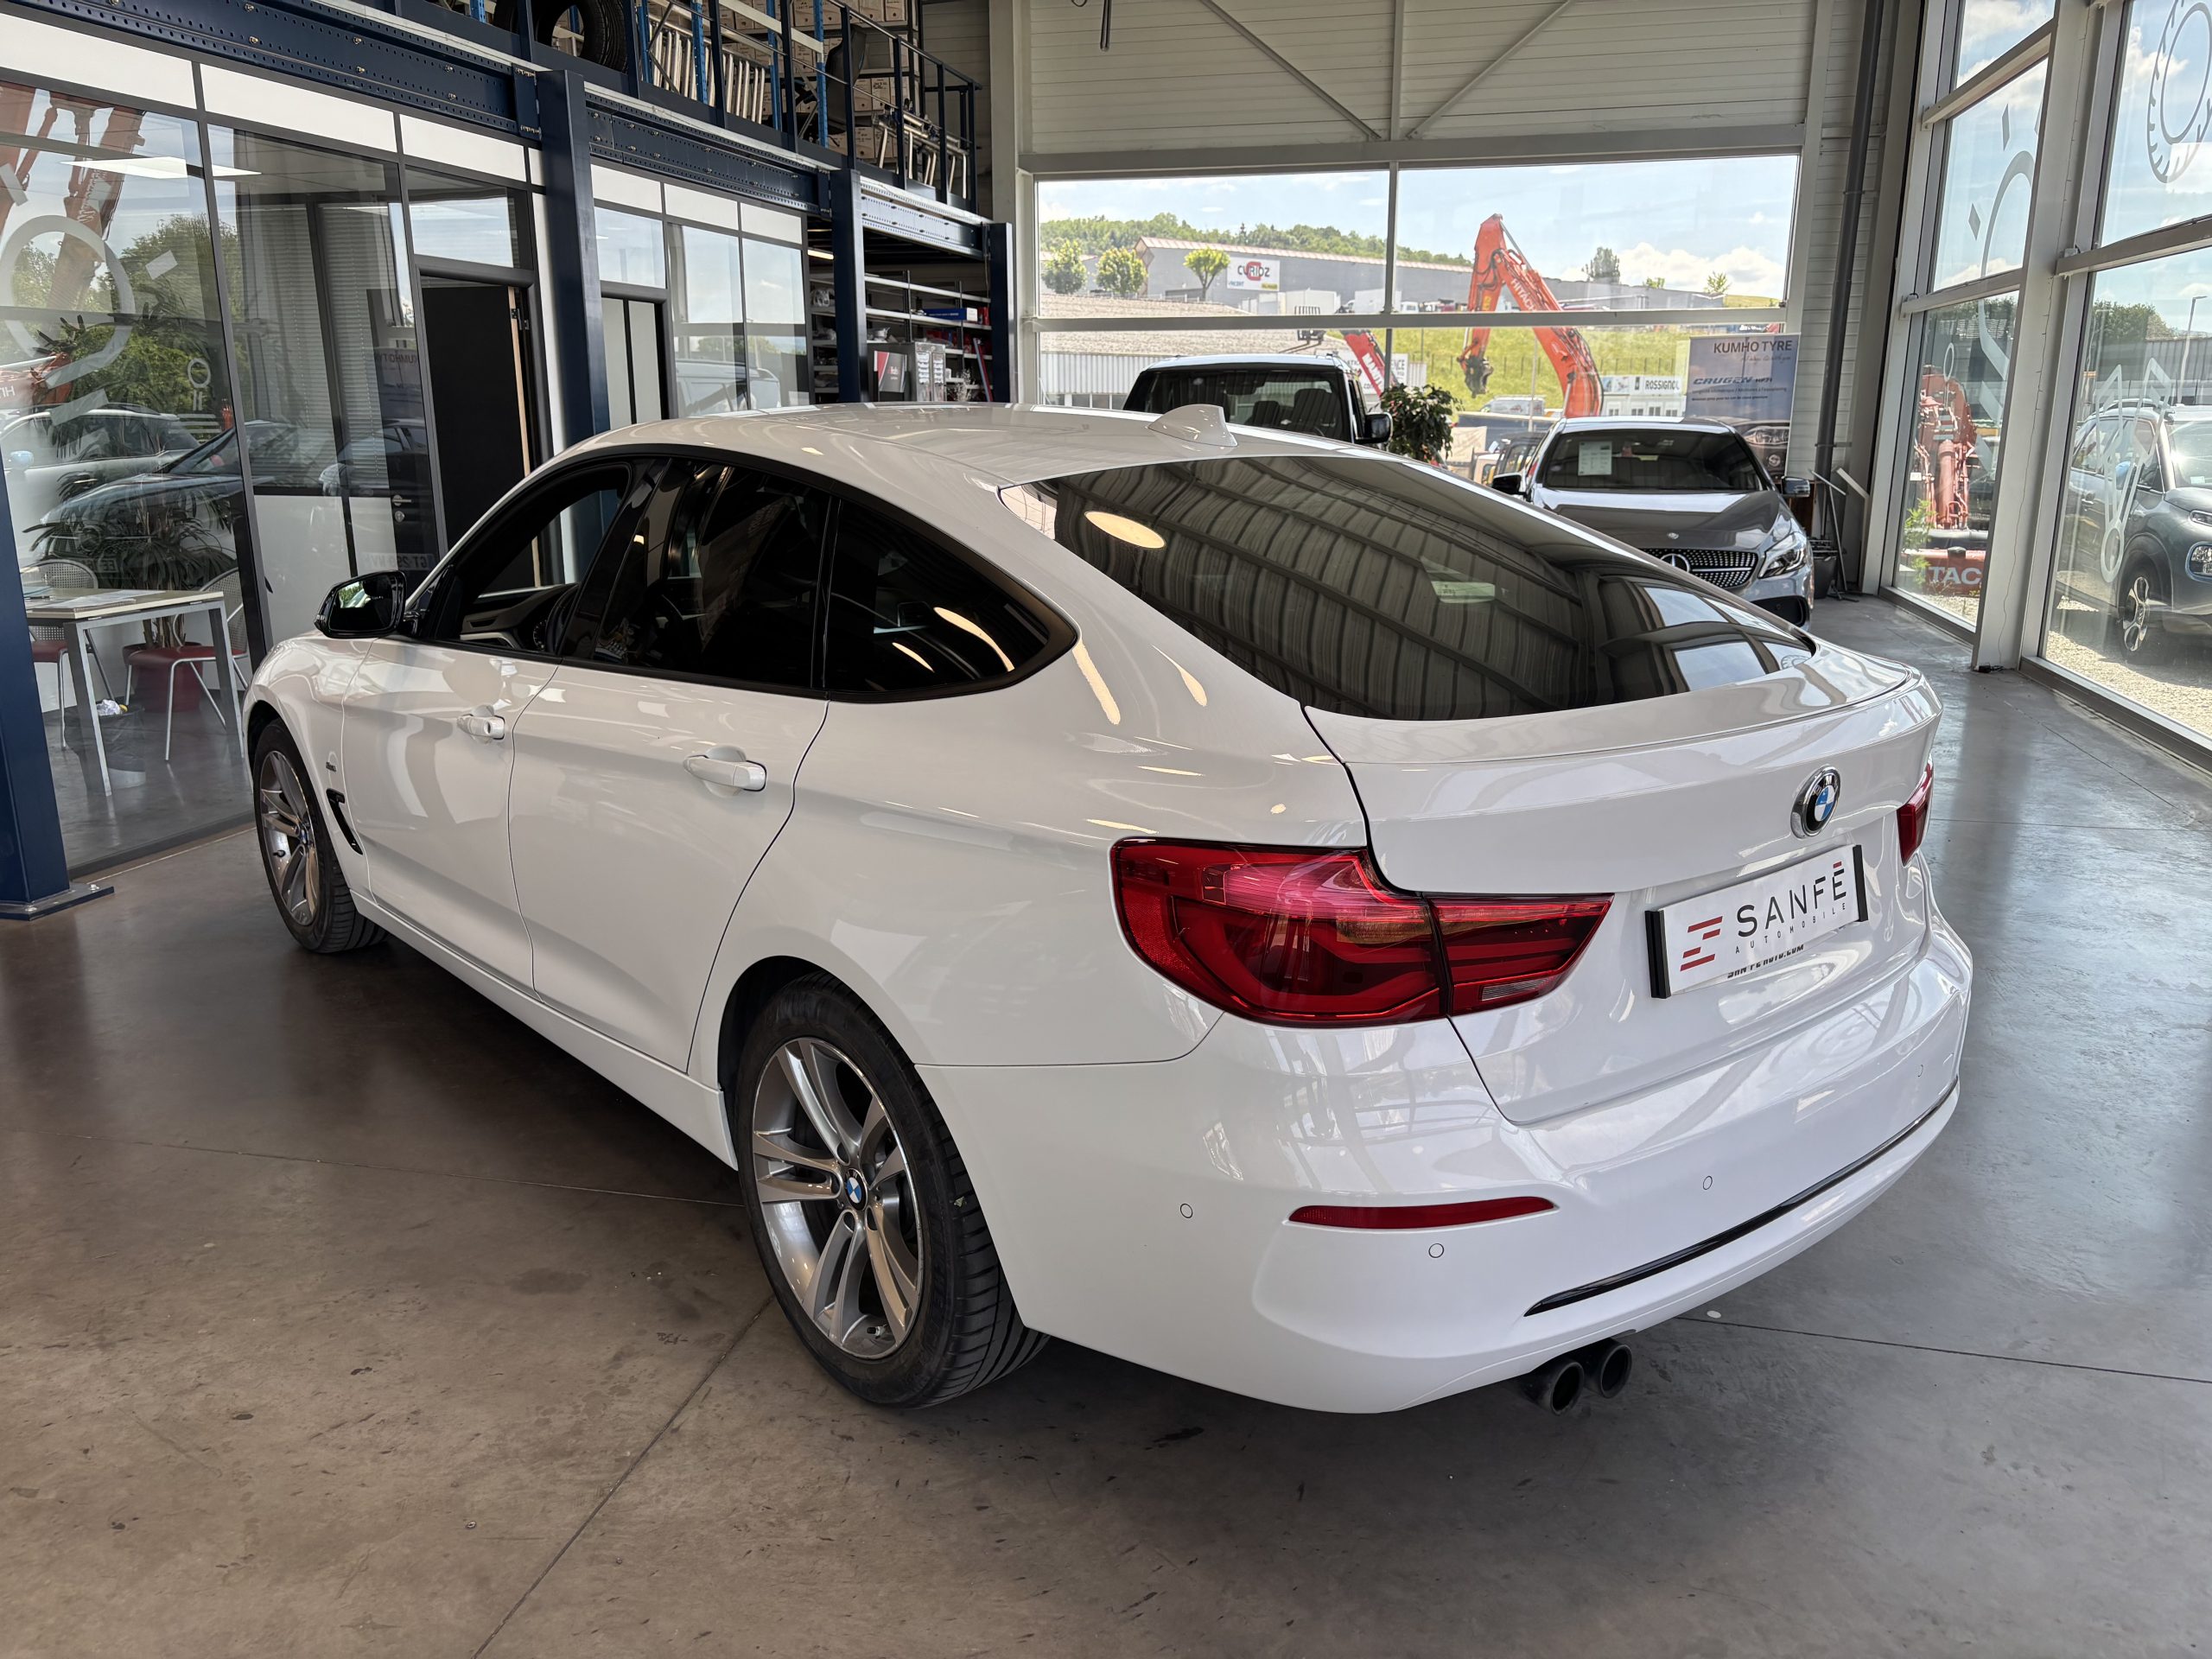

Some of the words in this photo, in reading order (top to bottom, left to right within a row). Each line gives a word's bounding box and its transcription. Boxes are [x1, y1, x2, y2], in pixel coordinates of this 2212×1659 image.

[1713, 341, 1759, 353] KUMHO
[1762, 340, 1793, 352] TYRE
[1735, 902, 1846, 954] AUTOMOBILE
